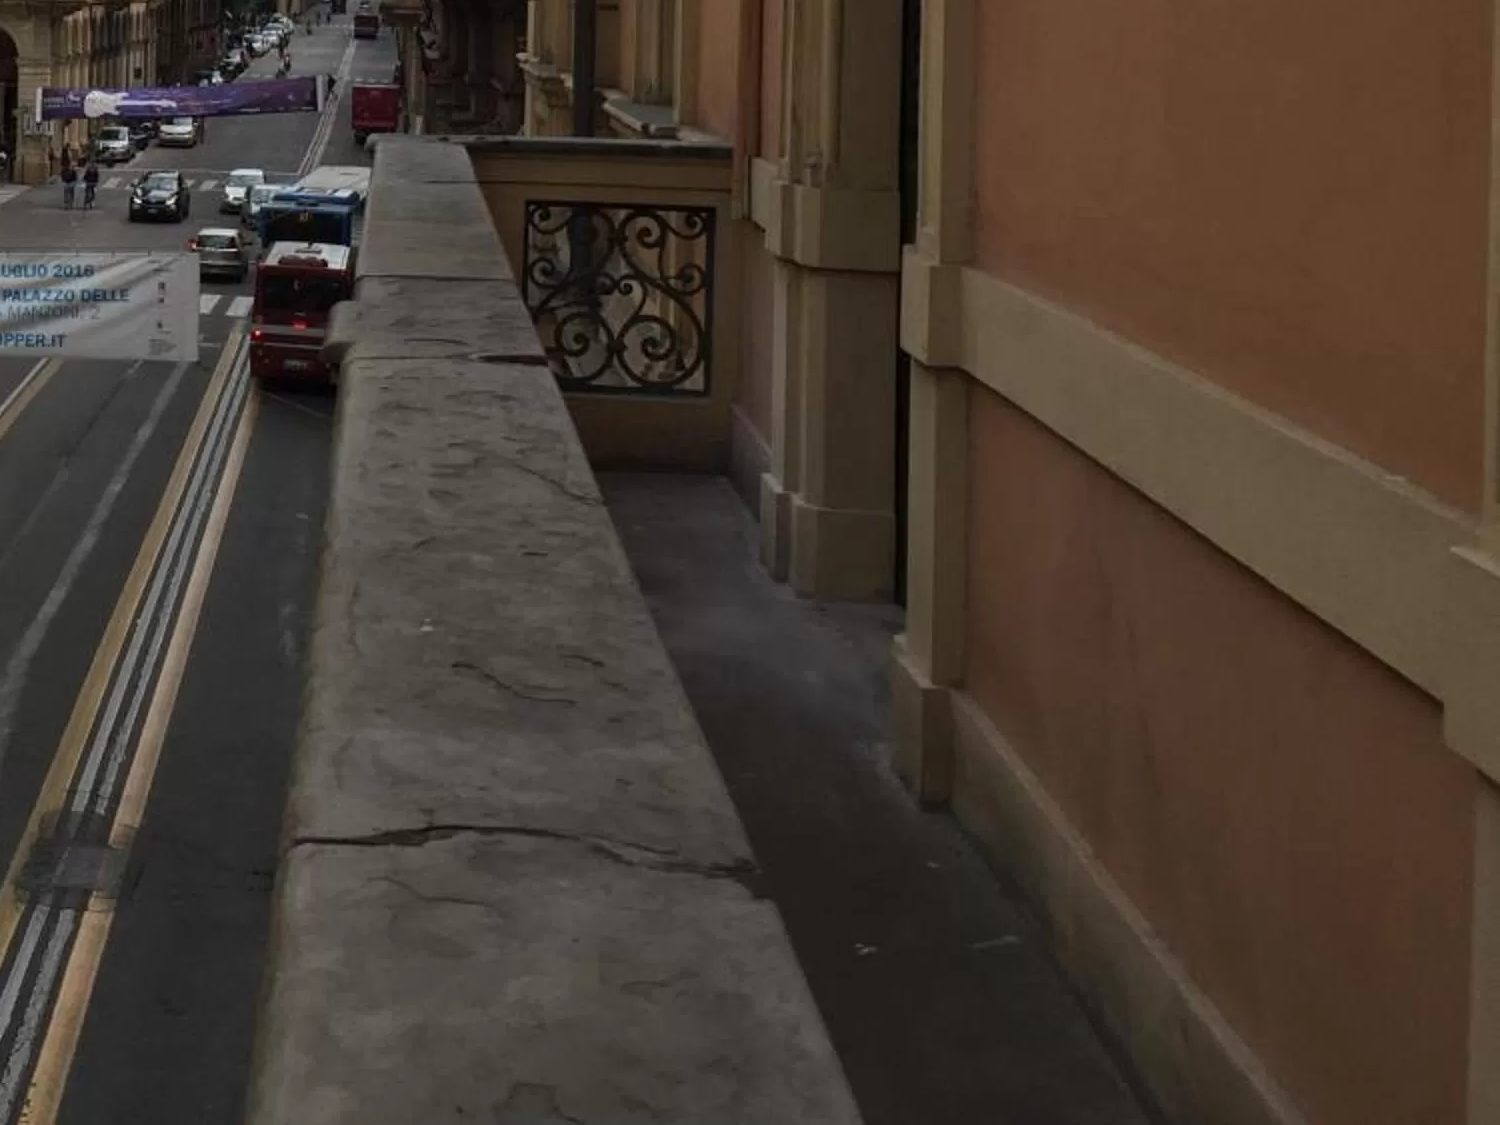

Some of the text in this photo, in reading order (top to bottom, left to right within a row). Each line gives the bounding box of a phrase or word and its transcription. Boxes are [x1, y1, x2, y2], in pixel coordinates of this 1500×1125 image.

[53, 264, 96, 278] 2016
[2, 287, 75, 303] PALAZZO
[80, 288, 130, 303] DELLE
